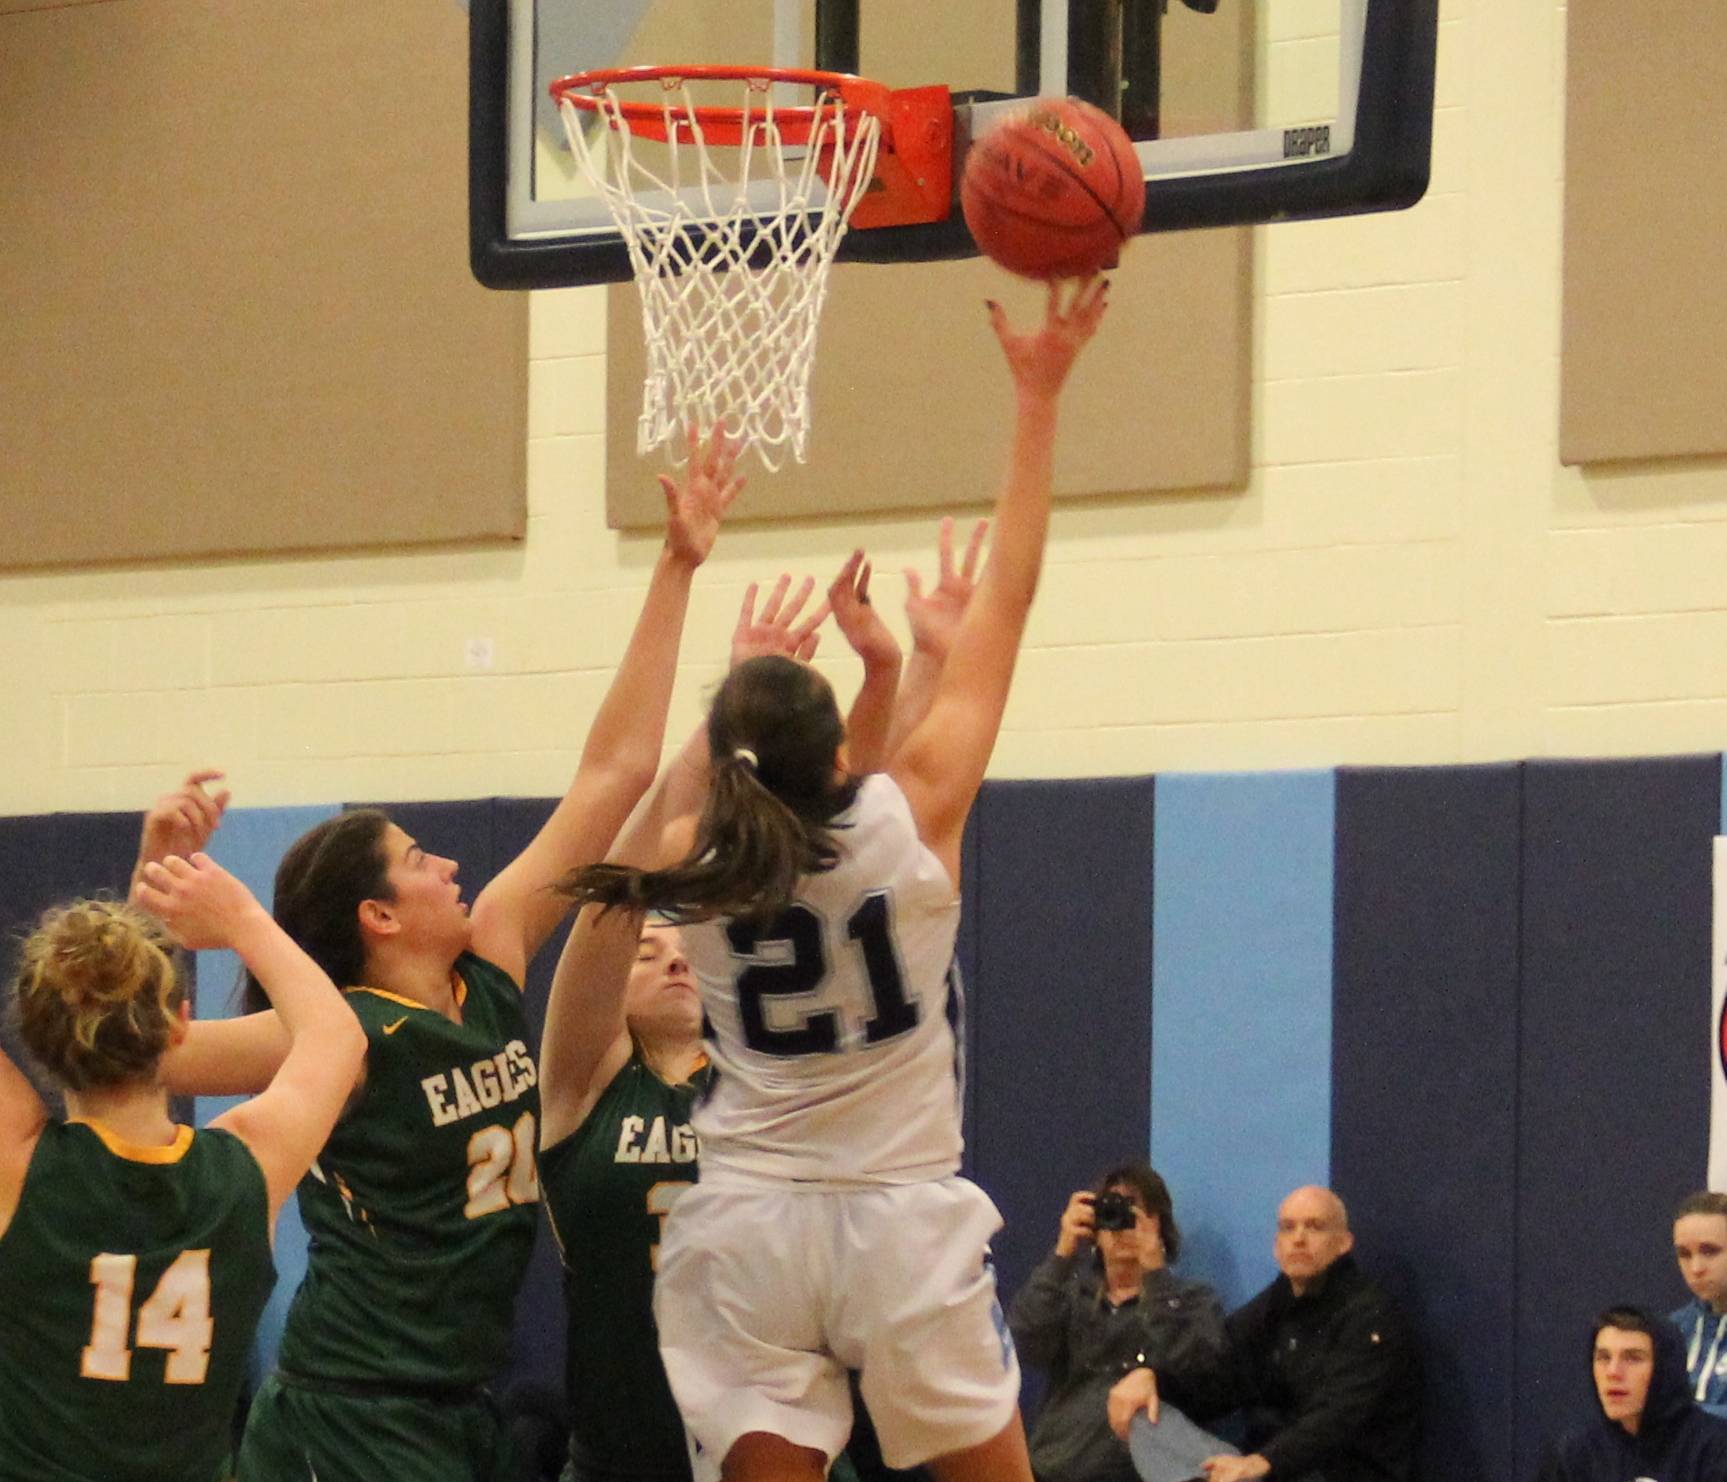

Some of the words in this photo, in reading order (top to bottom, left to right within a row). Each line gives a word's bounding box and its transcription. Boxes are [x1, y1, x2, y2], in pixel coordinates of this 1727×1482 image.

[1282, 125, 1330, 159] DRAPER
[725, 886, 923, 1060] 21
[421, 1039, 537, 1128] EAGLES
[614, 1114, 701, 1164] EAG
[80, 1248, 215, 1385] 14
